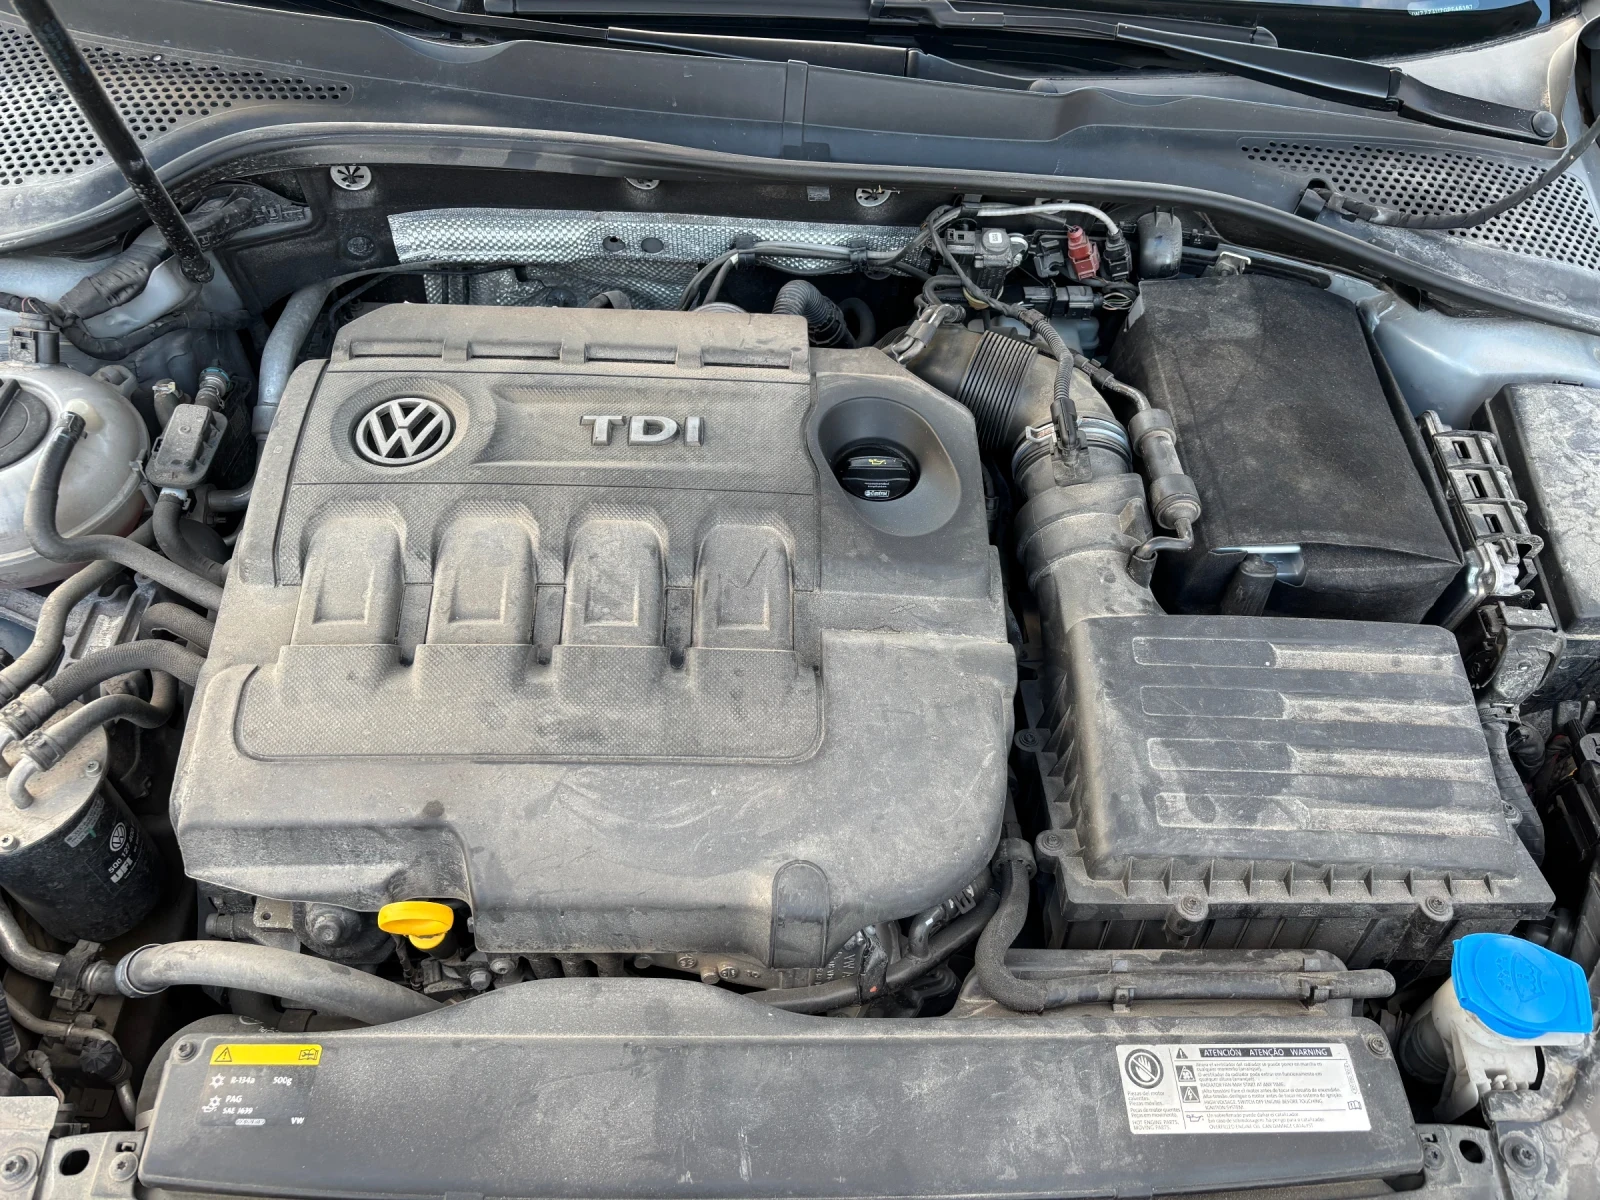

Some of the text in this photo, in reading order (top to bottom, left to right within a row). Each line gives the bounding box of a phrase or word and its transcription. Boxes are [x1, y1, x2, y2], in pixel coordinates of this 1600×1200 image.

[580, 414, 703, 447] TDI
[110, 857, 133, 883] UFI
[1204, 1048, 1242, 1056] ATENCIÓN
[1250, 1047, 1284, 1057] ATENÇÃO
[272, 1077, 292, 1086] 500g
